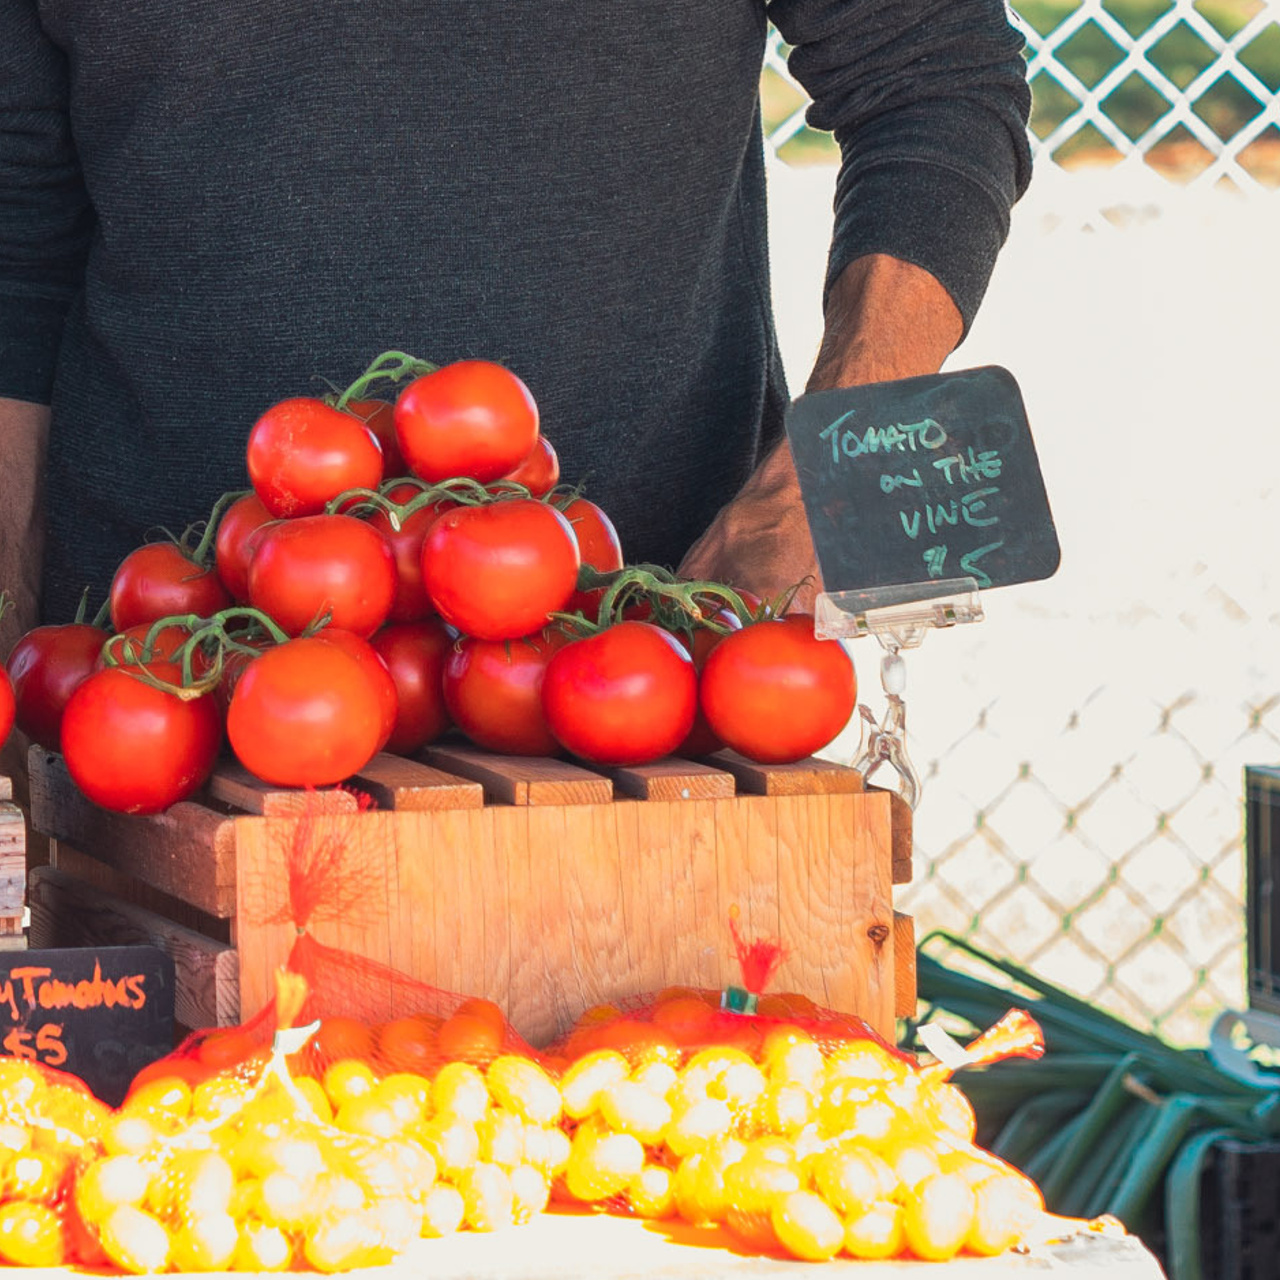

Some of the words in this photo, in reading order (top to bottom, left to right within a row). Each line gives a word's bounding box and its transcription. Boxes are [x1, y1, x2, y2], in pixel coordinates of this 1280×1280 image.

[820, 410, 947, 463] TOMATO
[933, 446, 1002, 484] THE
[900, 487, 1000, 539] VINE
[10, 957, 146, 1010] Tomatoes
